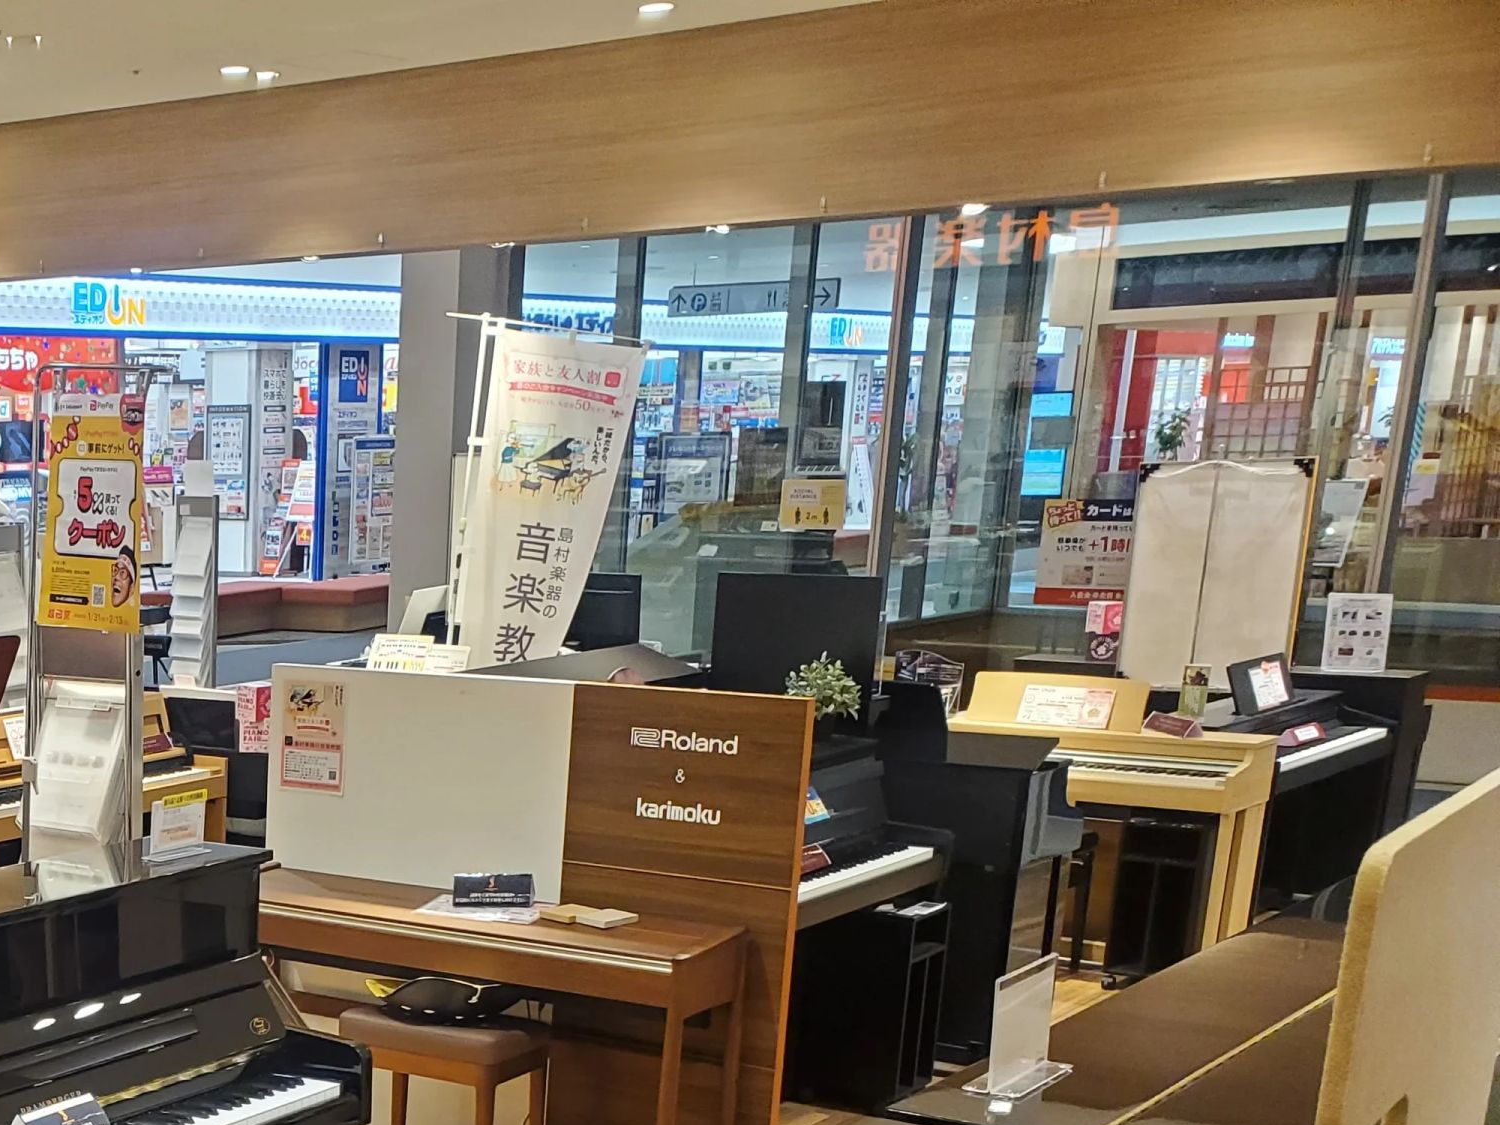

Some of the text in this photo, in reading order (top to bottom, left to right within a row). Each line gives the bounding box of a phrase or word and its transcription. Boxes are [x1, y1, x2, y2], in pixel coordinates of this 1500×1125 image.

[514, 359, 601, 386] 家族と友人割
[88, 442, 125, 454] 事前にゲット!
[68, 517, 126, 549] クーポン
[542, 527, 573, 619] 島村楽器の
[493, 522, 556, 663] 音楽教
[661, 729, 738, 755] Roland
[675, 768, 685, 783] &
[636, 797, 721, 825] karimoku
